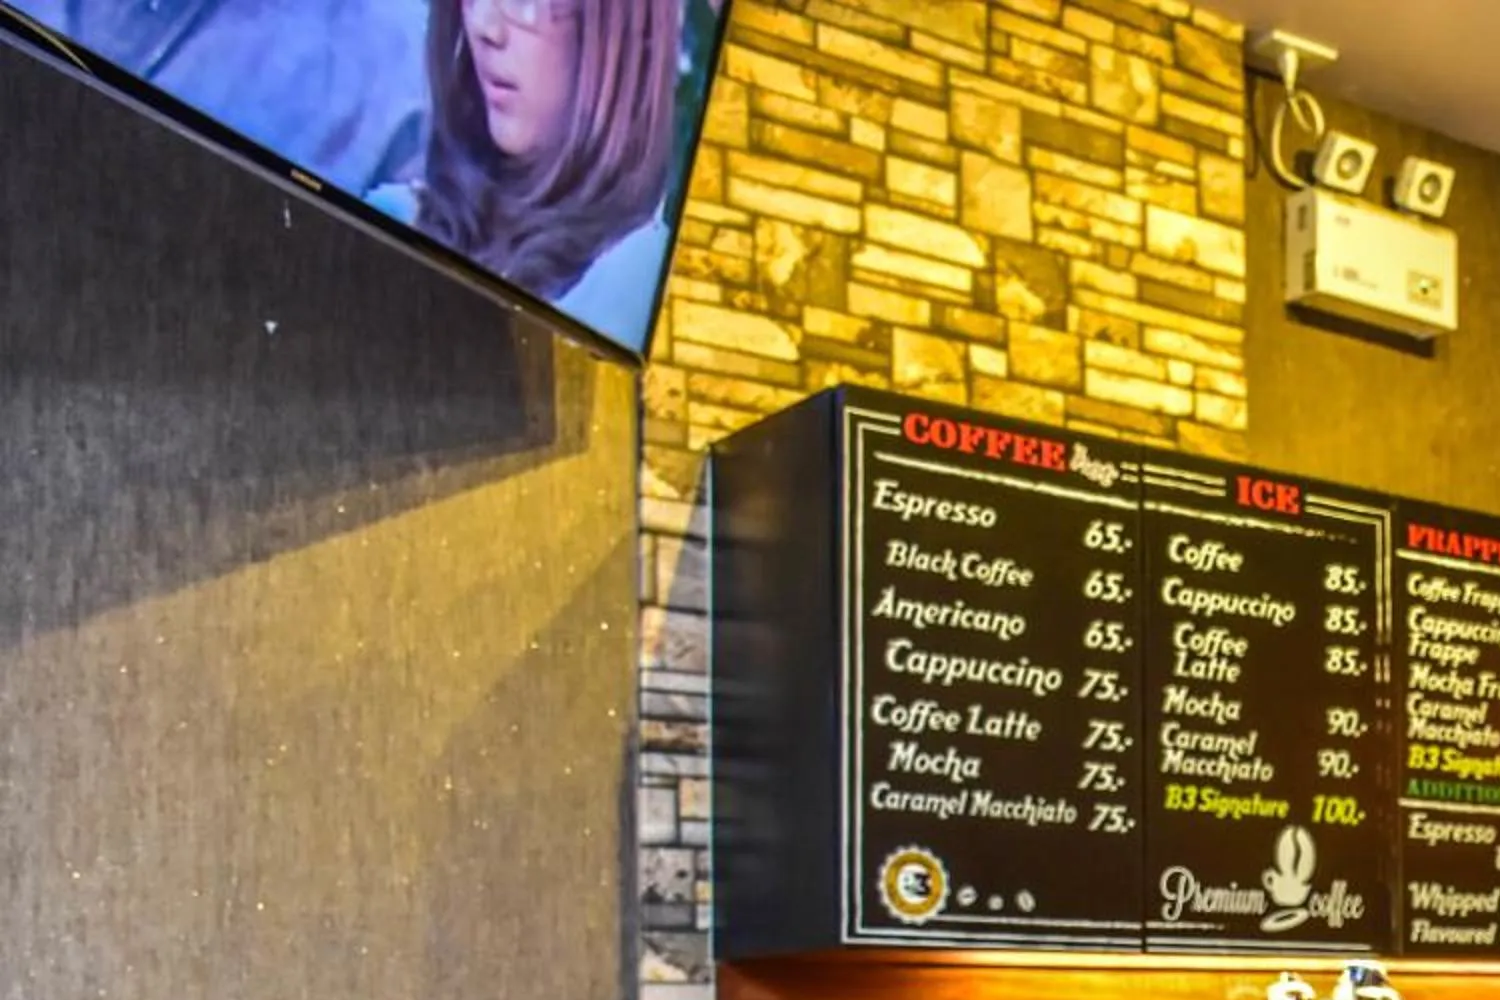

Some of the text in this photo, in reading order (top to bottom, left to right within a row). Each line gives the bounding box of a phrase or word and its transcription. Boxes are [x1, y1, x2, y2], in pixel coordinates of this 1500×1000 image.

[904, 413, 1065, 471] COFFEE
[873, 479, 997, 528] Espresso
[1236, 475, 1299, 514] ICE
[886, 540, 957, 581] Black
[961, 552, 1034, 587] Coffee
[1169, 535, 1243, 572] Coffee
[1162, 577, 1296, 627] Cappuccino
[1407, 573, 1460, 602] Coffee
[872, 586, 1026, 640] Americano
[1174, 622, 1247, 657] Coffee
[885, 638, 1063, 696] Cappuccino
[1174, 650, 1240, 682] Latte
[871, 694, 961, 733] Coffee
[966, 704, 1042, 741] Latte
[1163, 685, 1241, 725] Mocha
[1161, 721, 1258, 760] Caramel
[887, 742, 981, 782] Mocha
[1161, 749, 1274, 783] Macchiato
[870, 782, 967, 819] Caramel
[970, 790, 1078, 826] Macchiato
[1165, 784, 1197, 810] B3
[1199, 787, 1290, 819] Signature
[1408, 812, 1496, 846] Espresso
[1160, 865, 1365, 928] Premium coffee
[1408, 881, 1500, 917] Whipped
